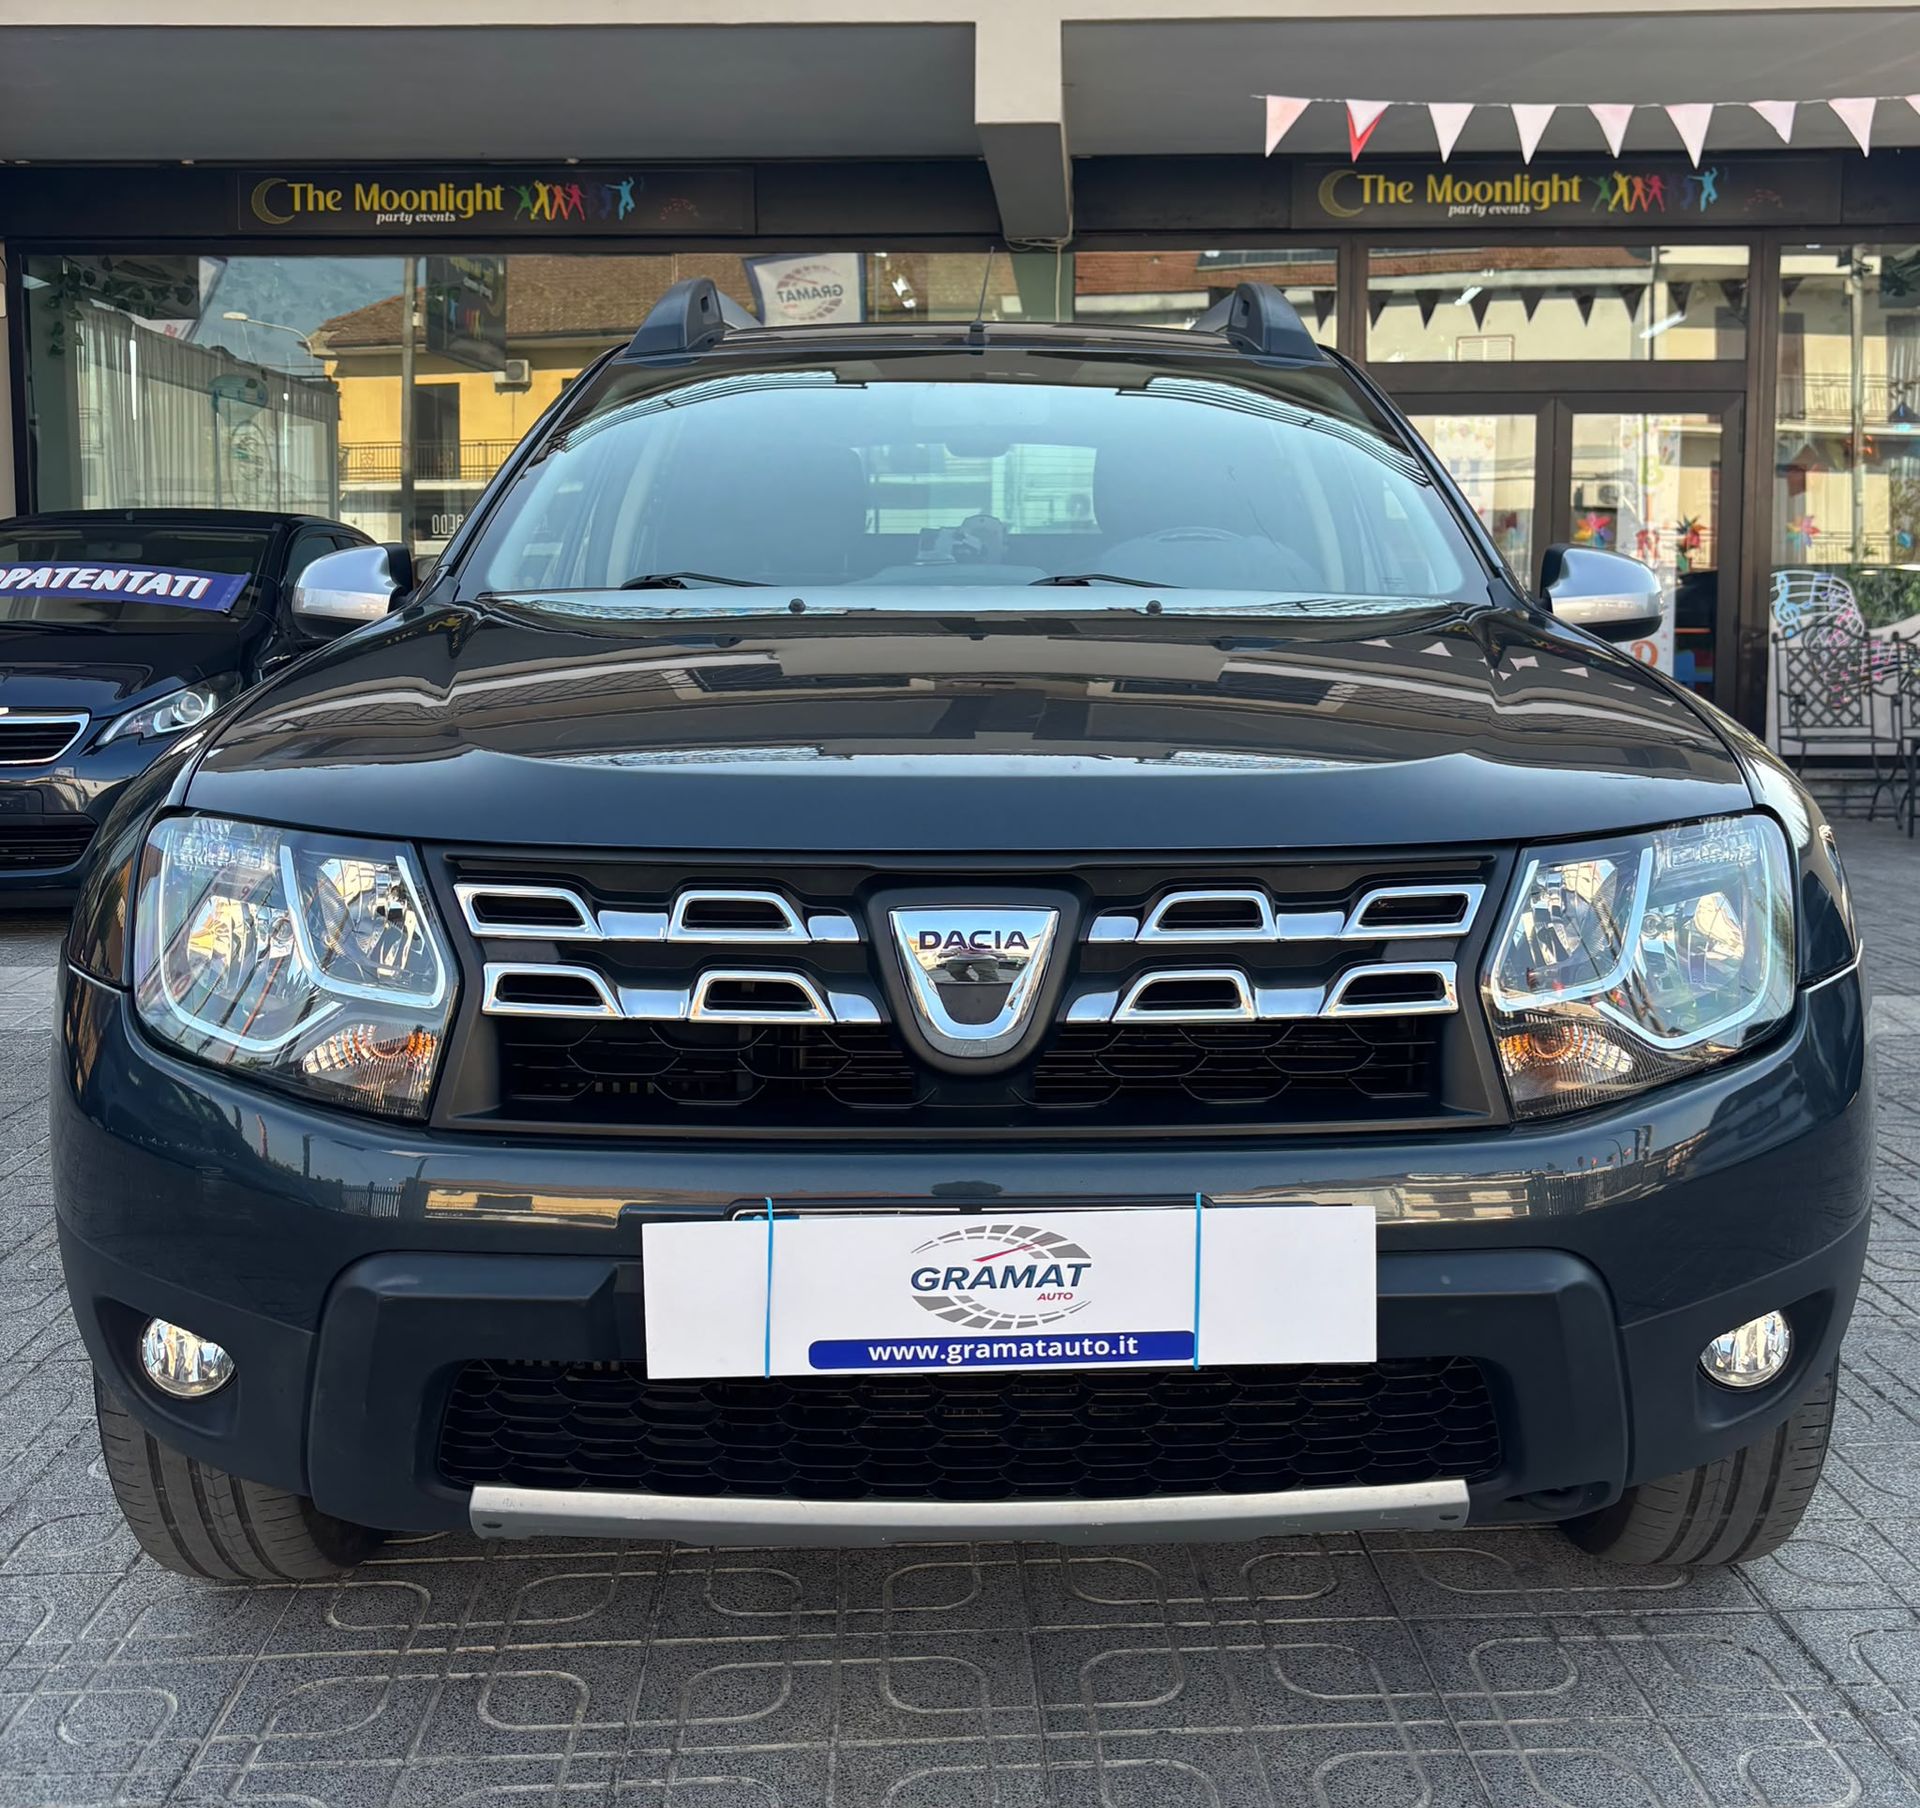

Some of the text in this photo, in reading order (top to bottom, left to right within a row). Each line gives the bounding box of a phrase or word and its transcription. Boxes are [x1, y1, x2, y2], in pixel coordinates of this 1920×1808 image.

[287, 182, 504, 219] The Moonlight
[1357, 173, 1582, 211] The Moonlight
[376, 211, 456, 225] party events
[1448, 203, 1531, 218] party events
[0, 566, 213, 600] PATENTATI
[919, 930, 1030, 950] DACIA
[910, 1262, 1092, 1291] GRAMAT
[1036, 1291, 1074, 1301] AUTO
[867, 1335, 1139, 1364] www.gramatauto.it
